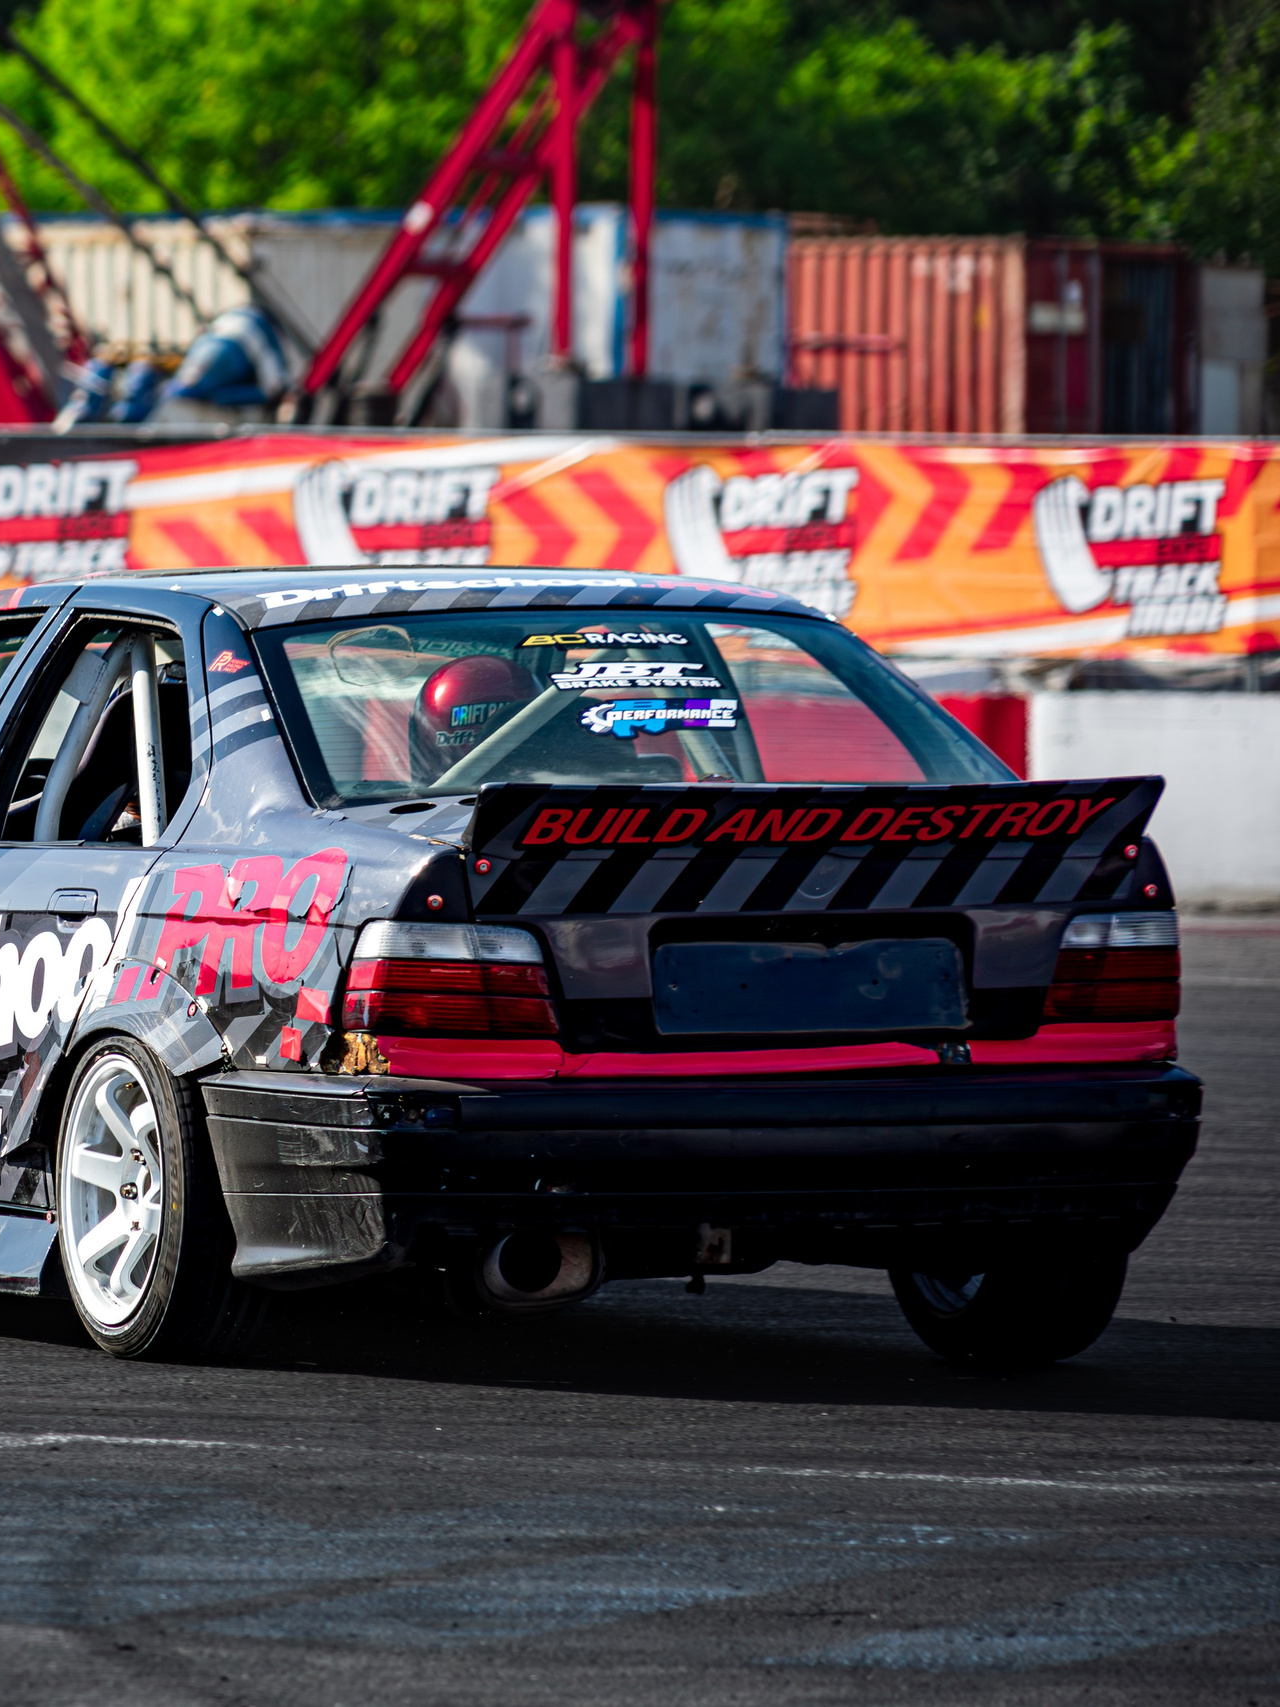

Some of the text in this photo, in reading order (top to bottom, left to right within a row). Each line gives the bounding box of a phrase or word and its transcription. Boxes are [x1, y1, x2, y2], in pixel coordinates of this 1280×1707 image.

[352, 467, 500, 526] DRIFT
[722, 467, 858, 531] DRIFT
[1088, 479, 1226, 543] DRIFT
[557, 679, 721, 690] BRAKE SYSTEM
[451, 703, 487, 727] DRIFT
[606, 707, 734, 721] PERFORMANCE
[521, 797, 1117, 845] BUILD AND DESTROY
